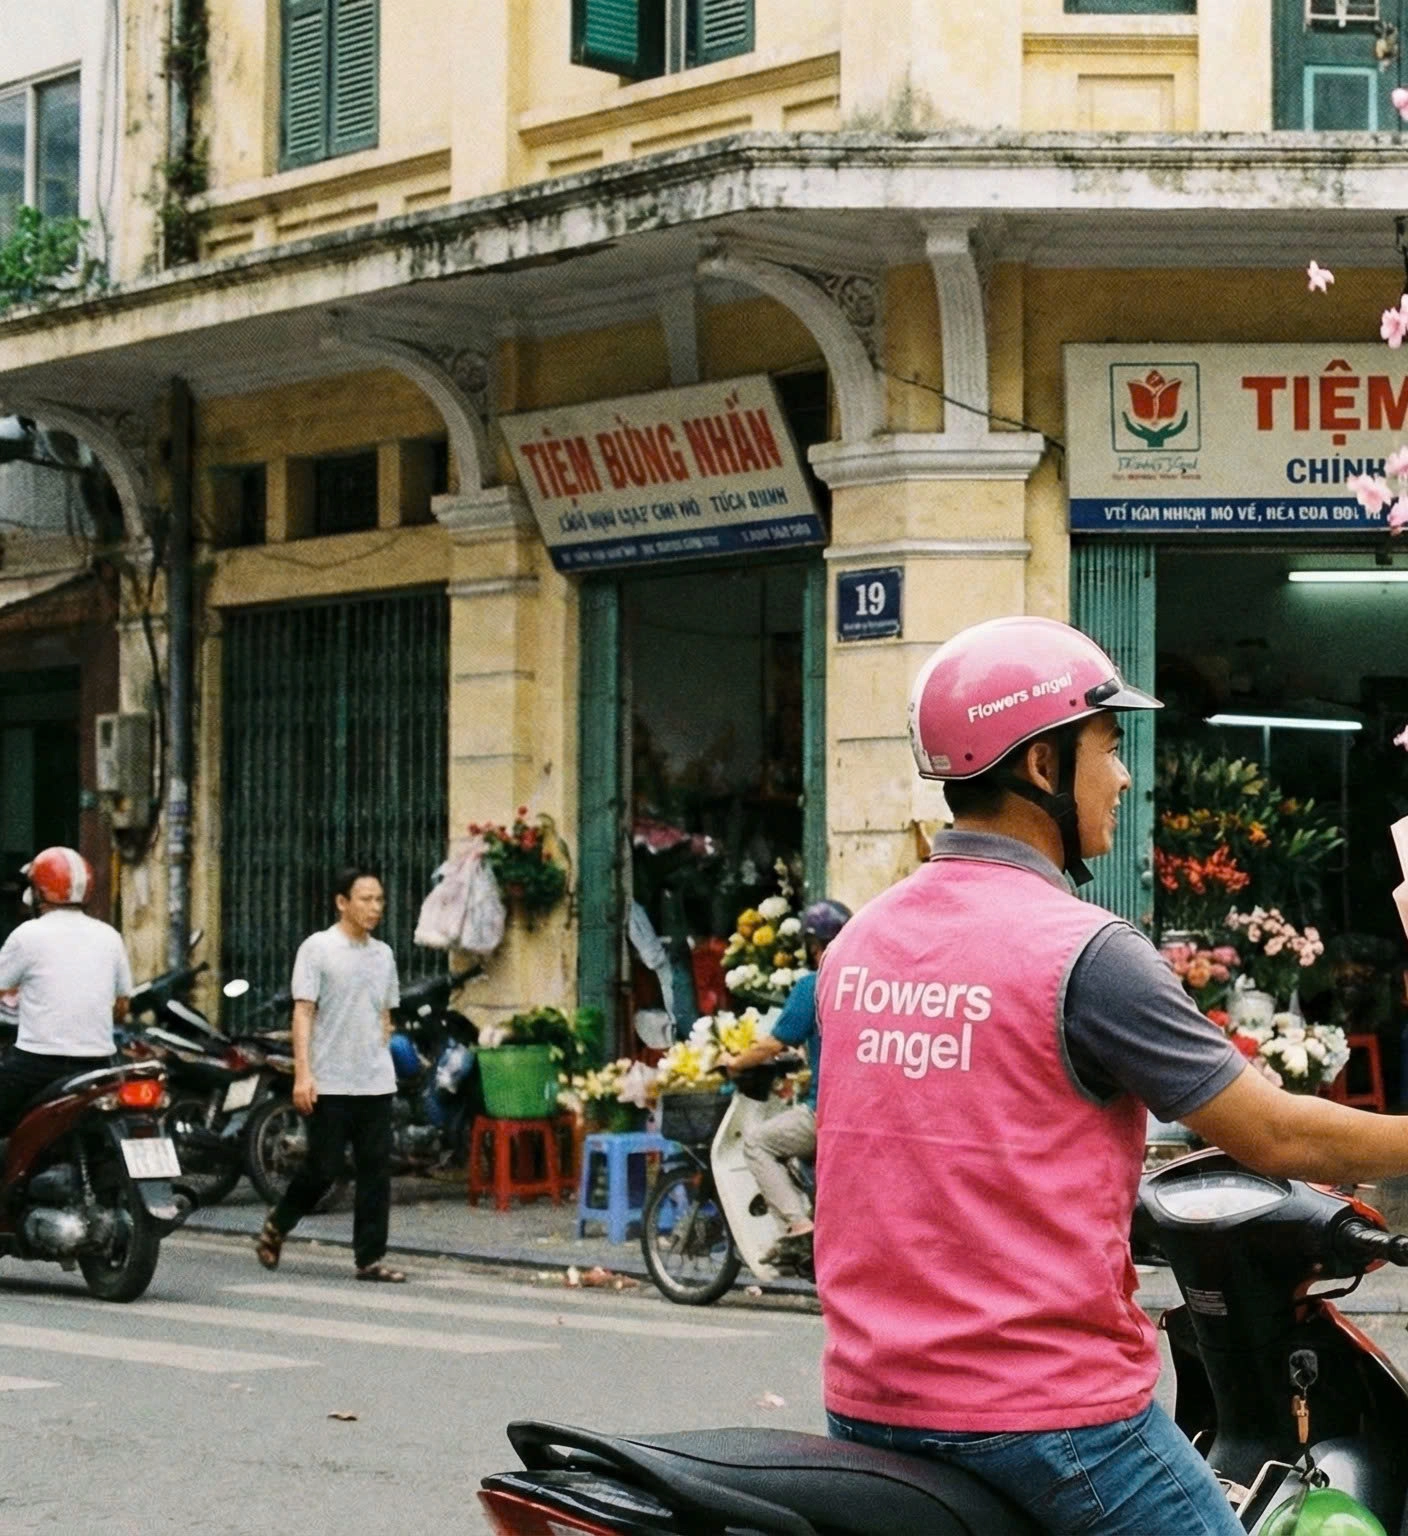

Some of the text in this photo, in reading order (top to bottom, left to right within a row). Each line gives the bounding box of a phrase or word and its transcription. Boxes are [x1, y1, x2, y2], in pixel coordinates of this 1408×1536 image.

[855, 582, 886, 615] 19
[967, 689, 1029, 723] Flowers
[834, 966, 993, 1022] Flowers
[856, 1022, 973, 1080] angel
